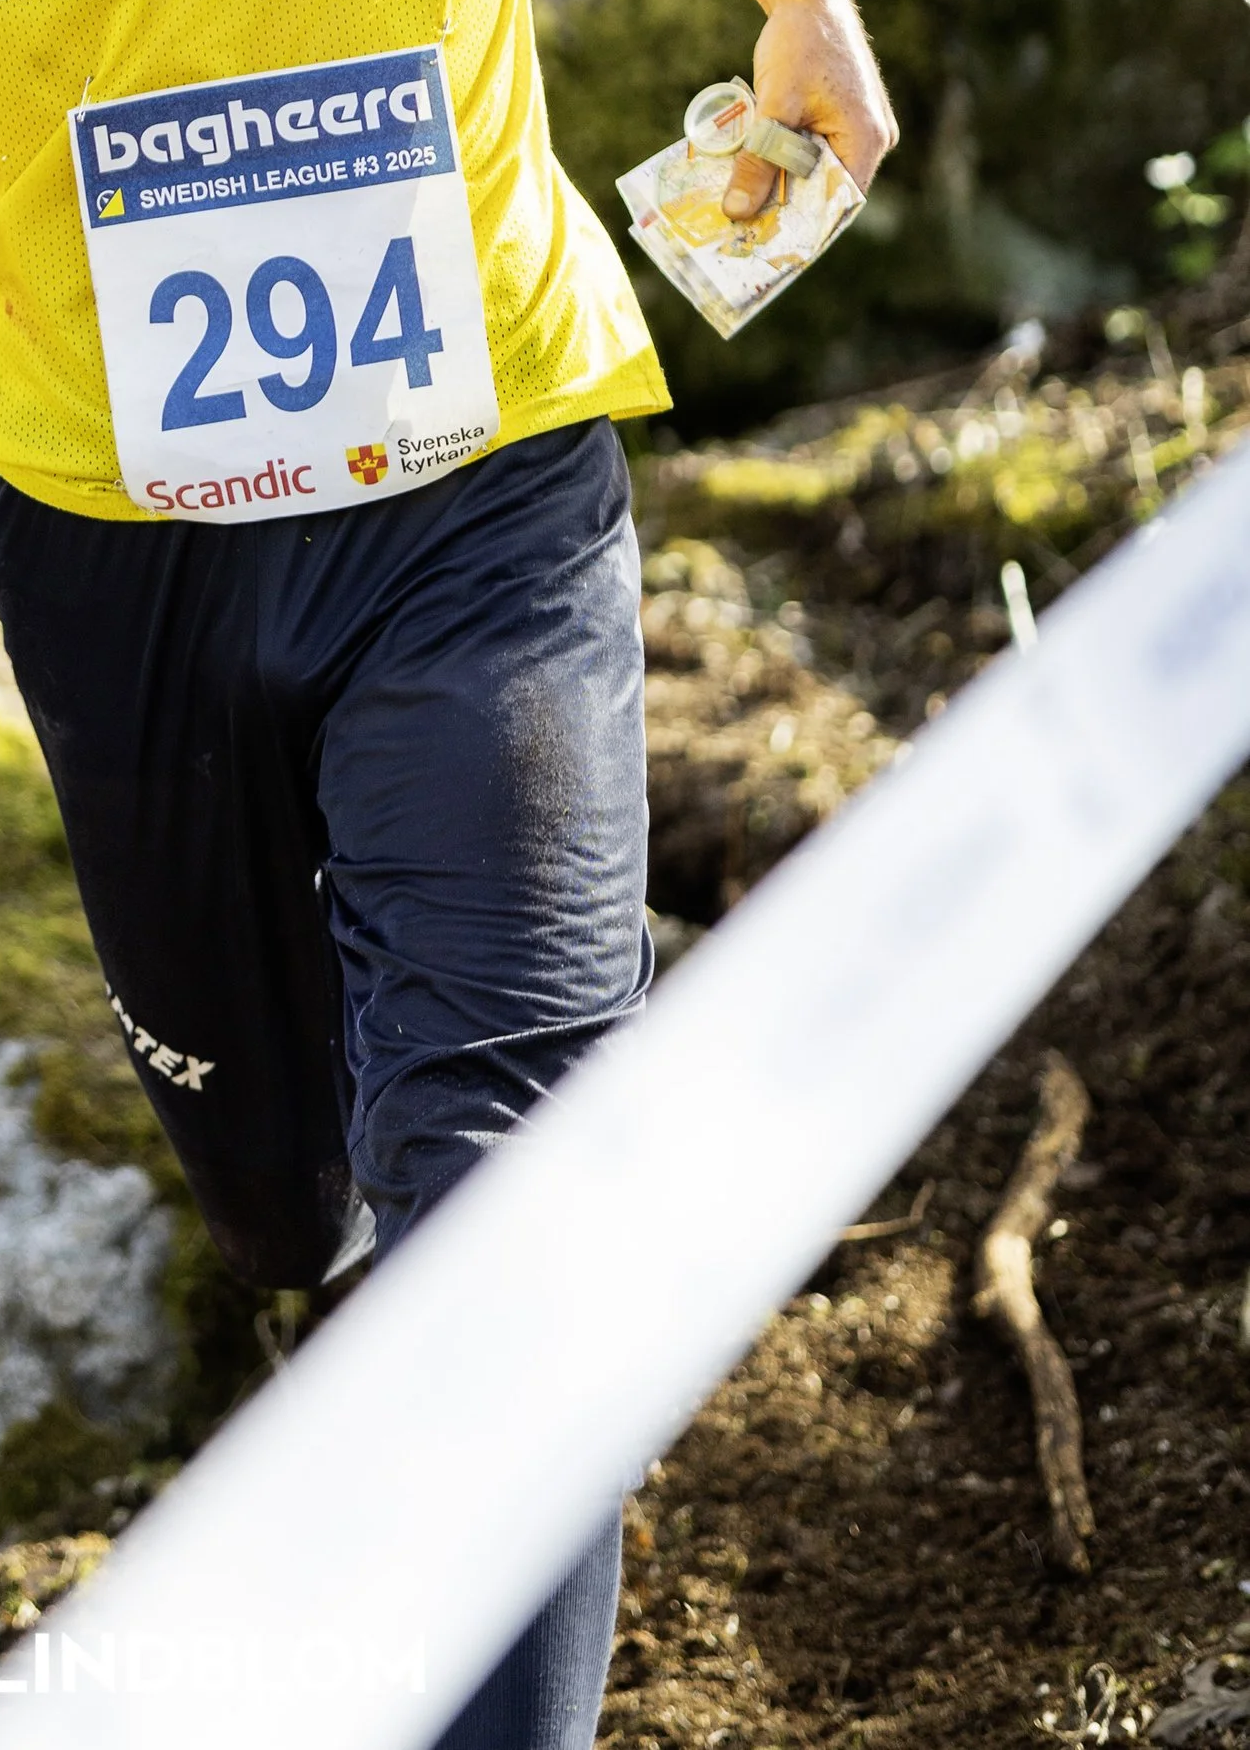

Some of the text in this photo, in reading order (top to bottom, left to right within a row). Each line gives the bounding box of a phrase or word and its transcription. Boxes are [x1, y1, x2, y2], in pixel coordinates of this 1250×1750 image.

[92, 78, 435, 174] bagheera
[140, 146, 437, 209] SWEDISH LEAGUE #3 2025
[149, 236, 444, 432] 294
[397, 426, 485, 456] Svenska
[401, 444, 472, 476] kyrkan
[146, 458, 317, 511] Scandic
